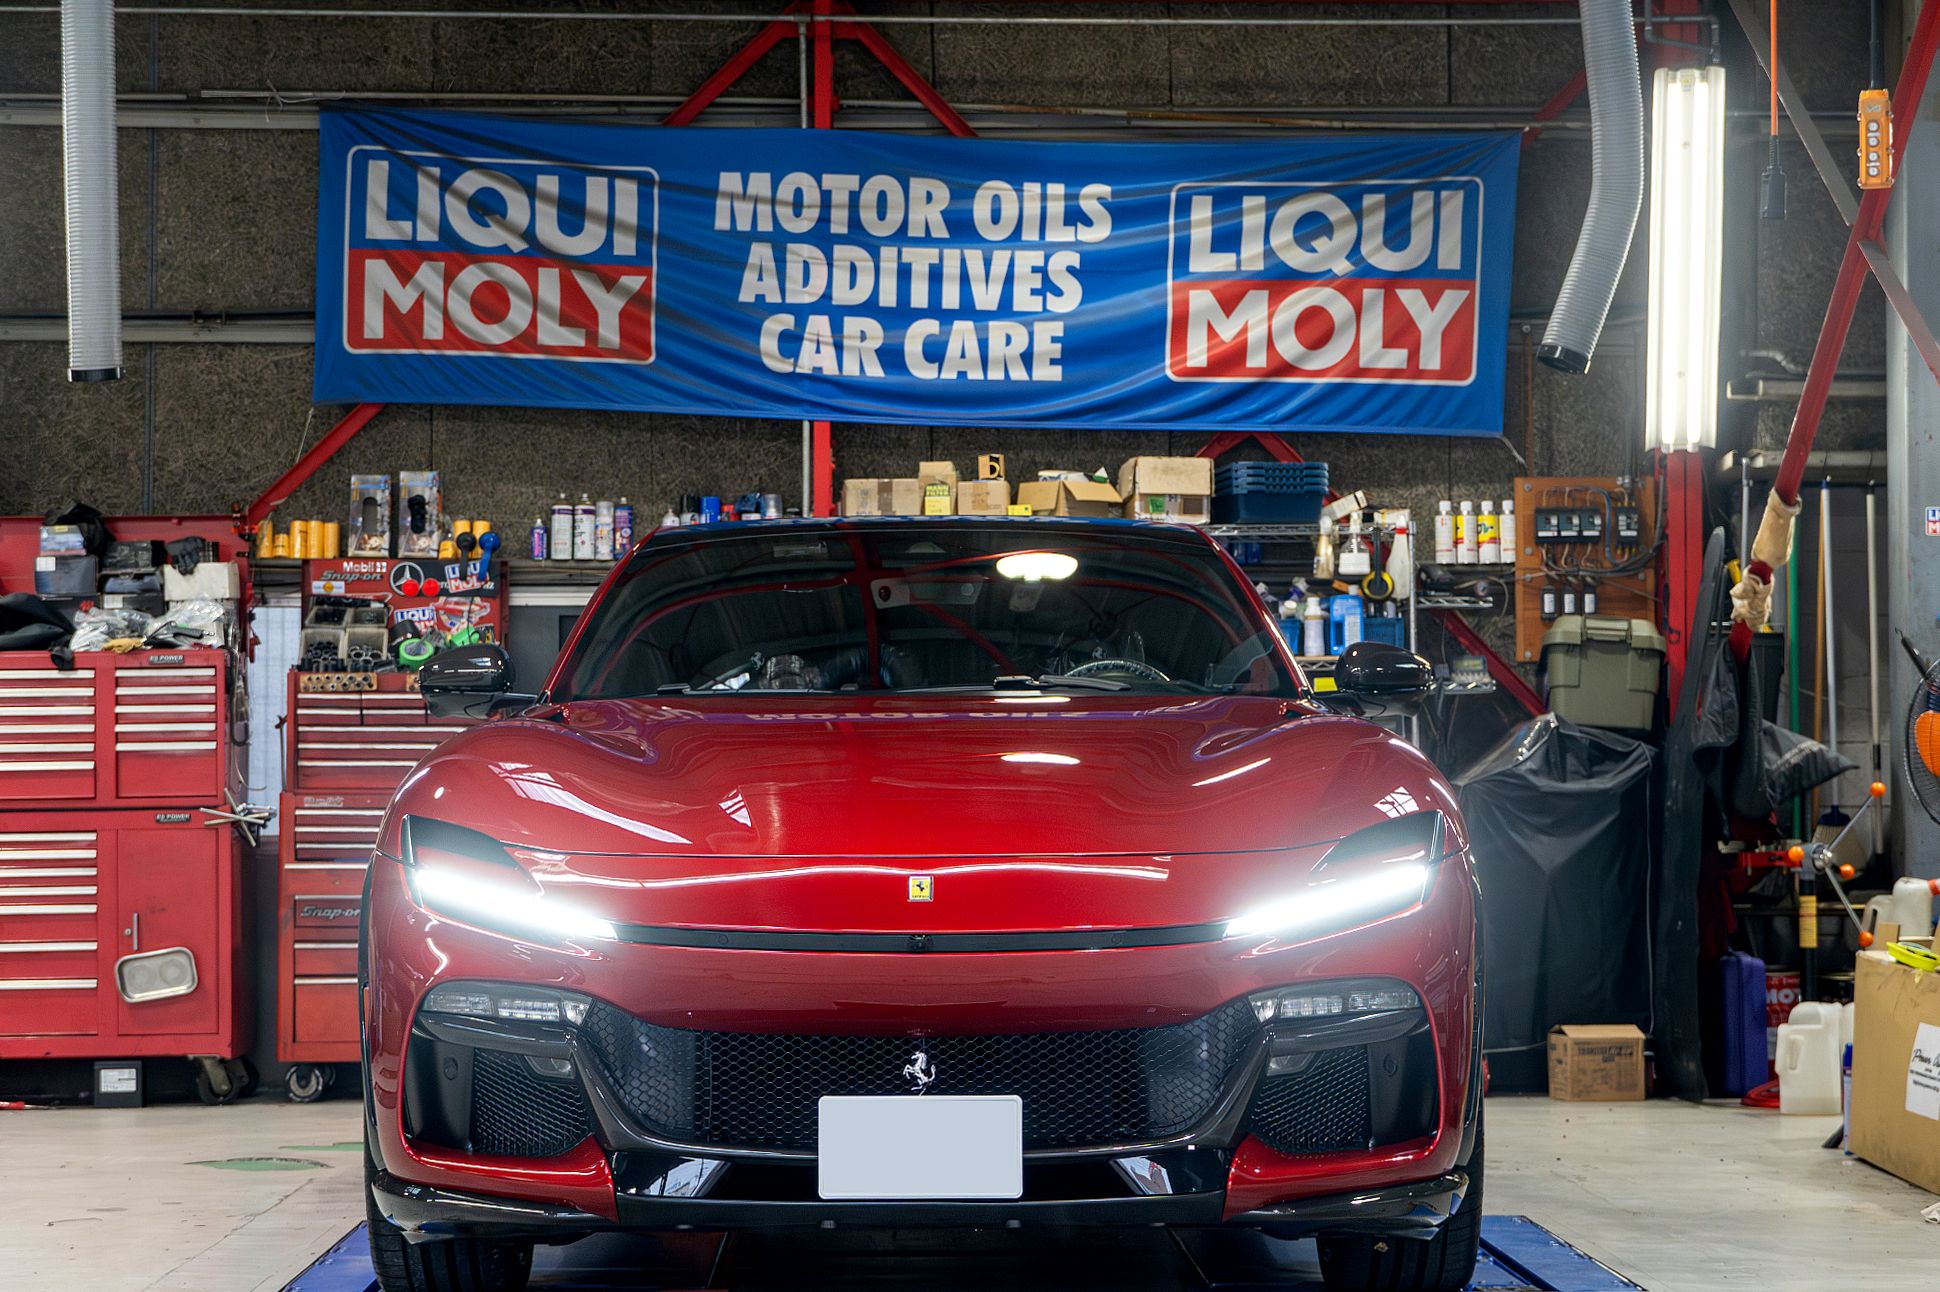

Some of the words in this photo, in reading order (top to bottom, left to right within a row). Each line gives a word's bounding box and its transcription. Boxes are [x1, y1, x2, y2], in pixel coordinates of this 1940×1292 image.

[365, 160, 639, 255] LIQUI
[713, 171, 950, 238] MOTOR
[972, 179, 1113, 243] OILS
[1188, 189, 1465, 277] LIQUI
[363, 258, 648, 350] MOLY
[738, 241, 1083, 313] ADDITIVES
[759, 313, 886, 377] CAR
[903, 318, 1065, 381] CARE
[1186, 286, 1471, 371] MOLY
[320, 570, 383, 583] Snap-on
[343, 561, 374, 572] Mobil
